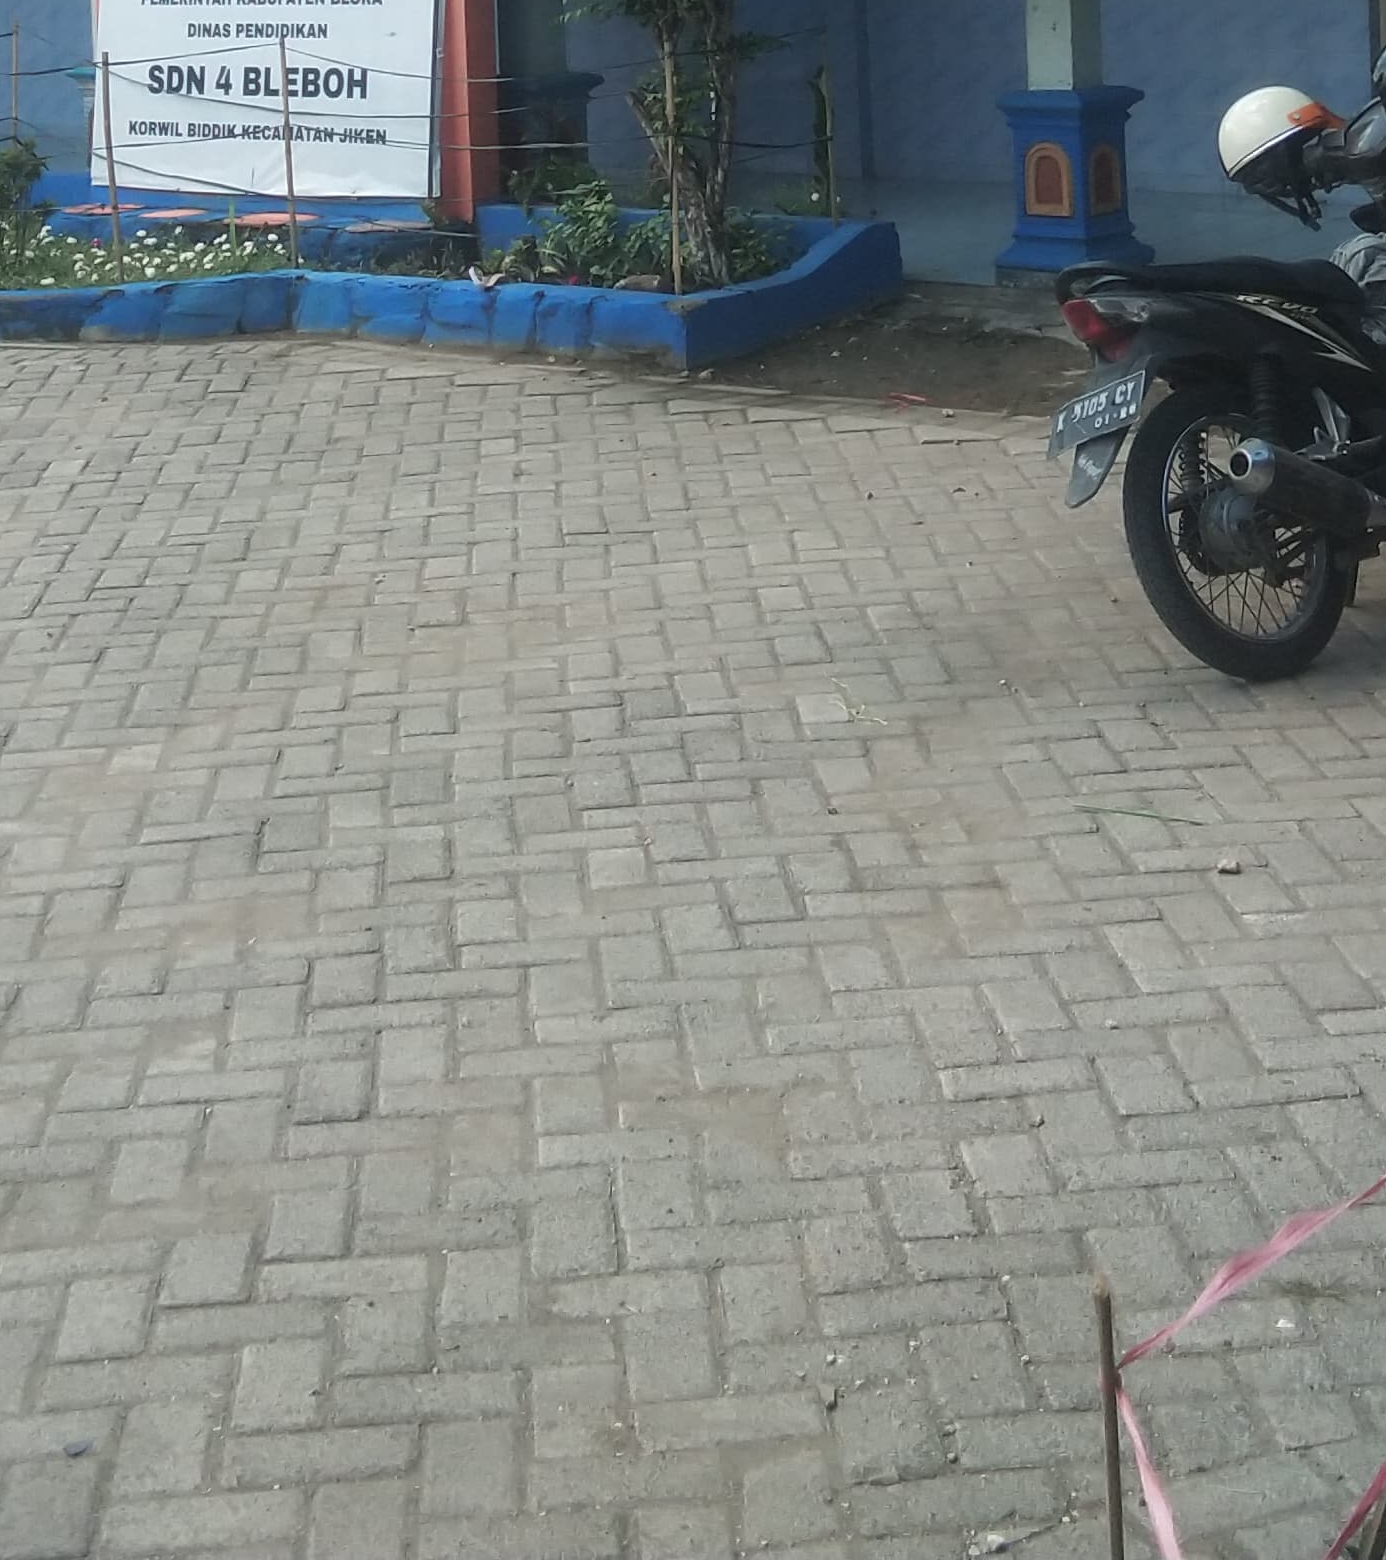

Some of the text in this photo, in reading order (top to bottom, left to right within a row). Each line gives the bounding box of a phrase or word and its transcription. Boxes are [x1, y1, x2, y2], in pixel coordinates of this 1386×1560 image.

[187, 23, 328, 39] DINAS PENDIDIKAN
[148, 65, 368, 99] SDN 4 BLEBOH
[129, 120, 183, 137] KORWIL
[188, 123, 236, 139] BIDDIK
[339, 127, 387, 145] JIKEN
[1115, 381, 1136, 404] CY
